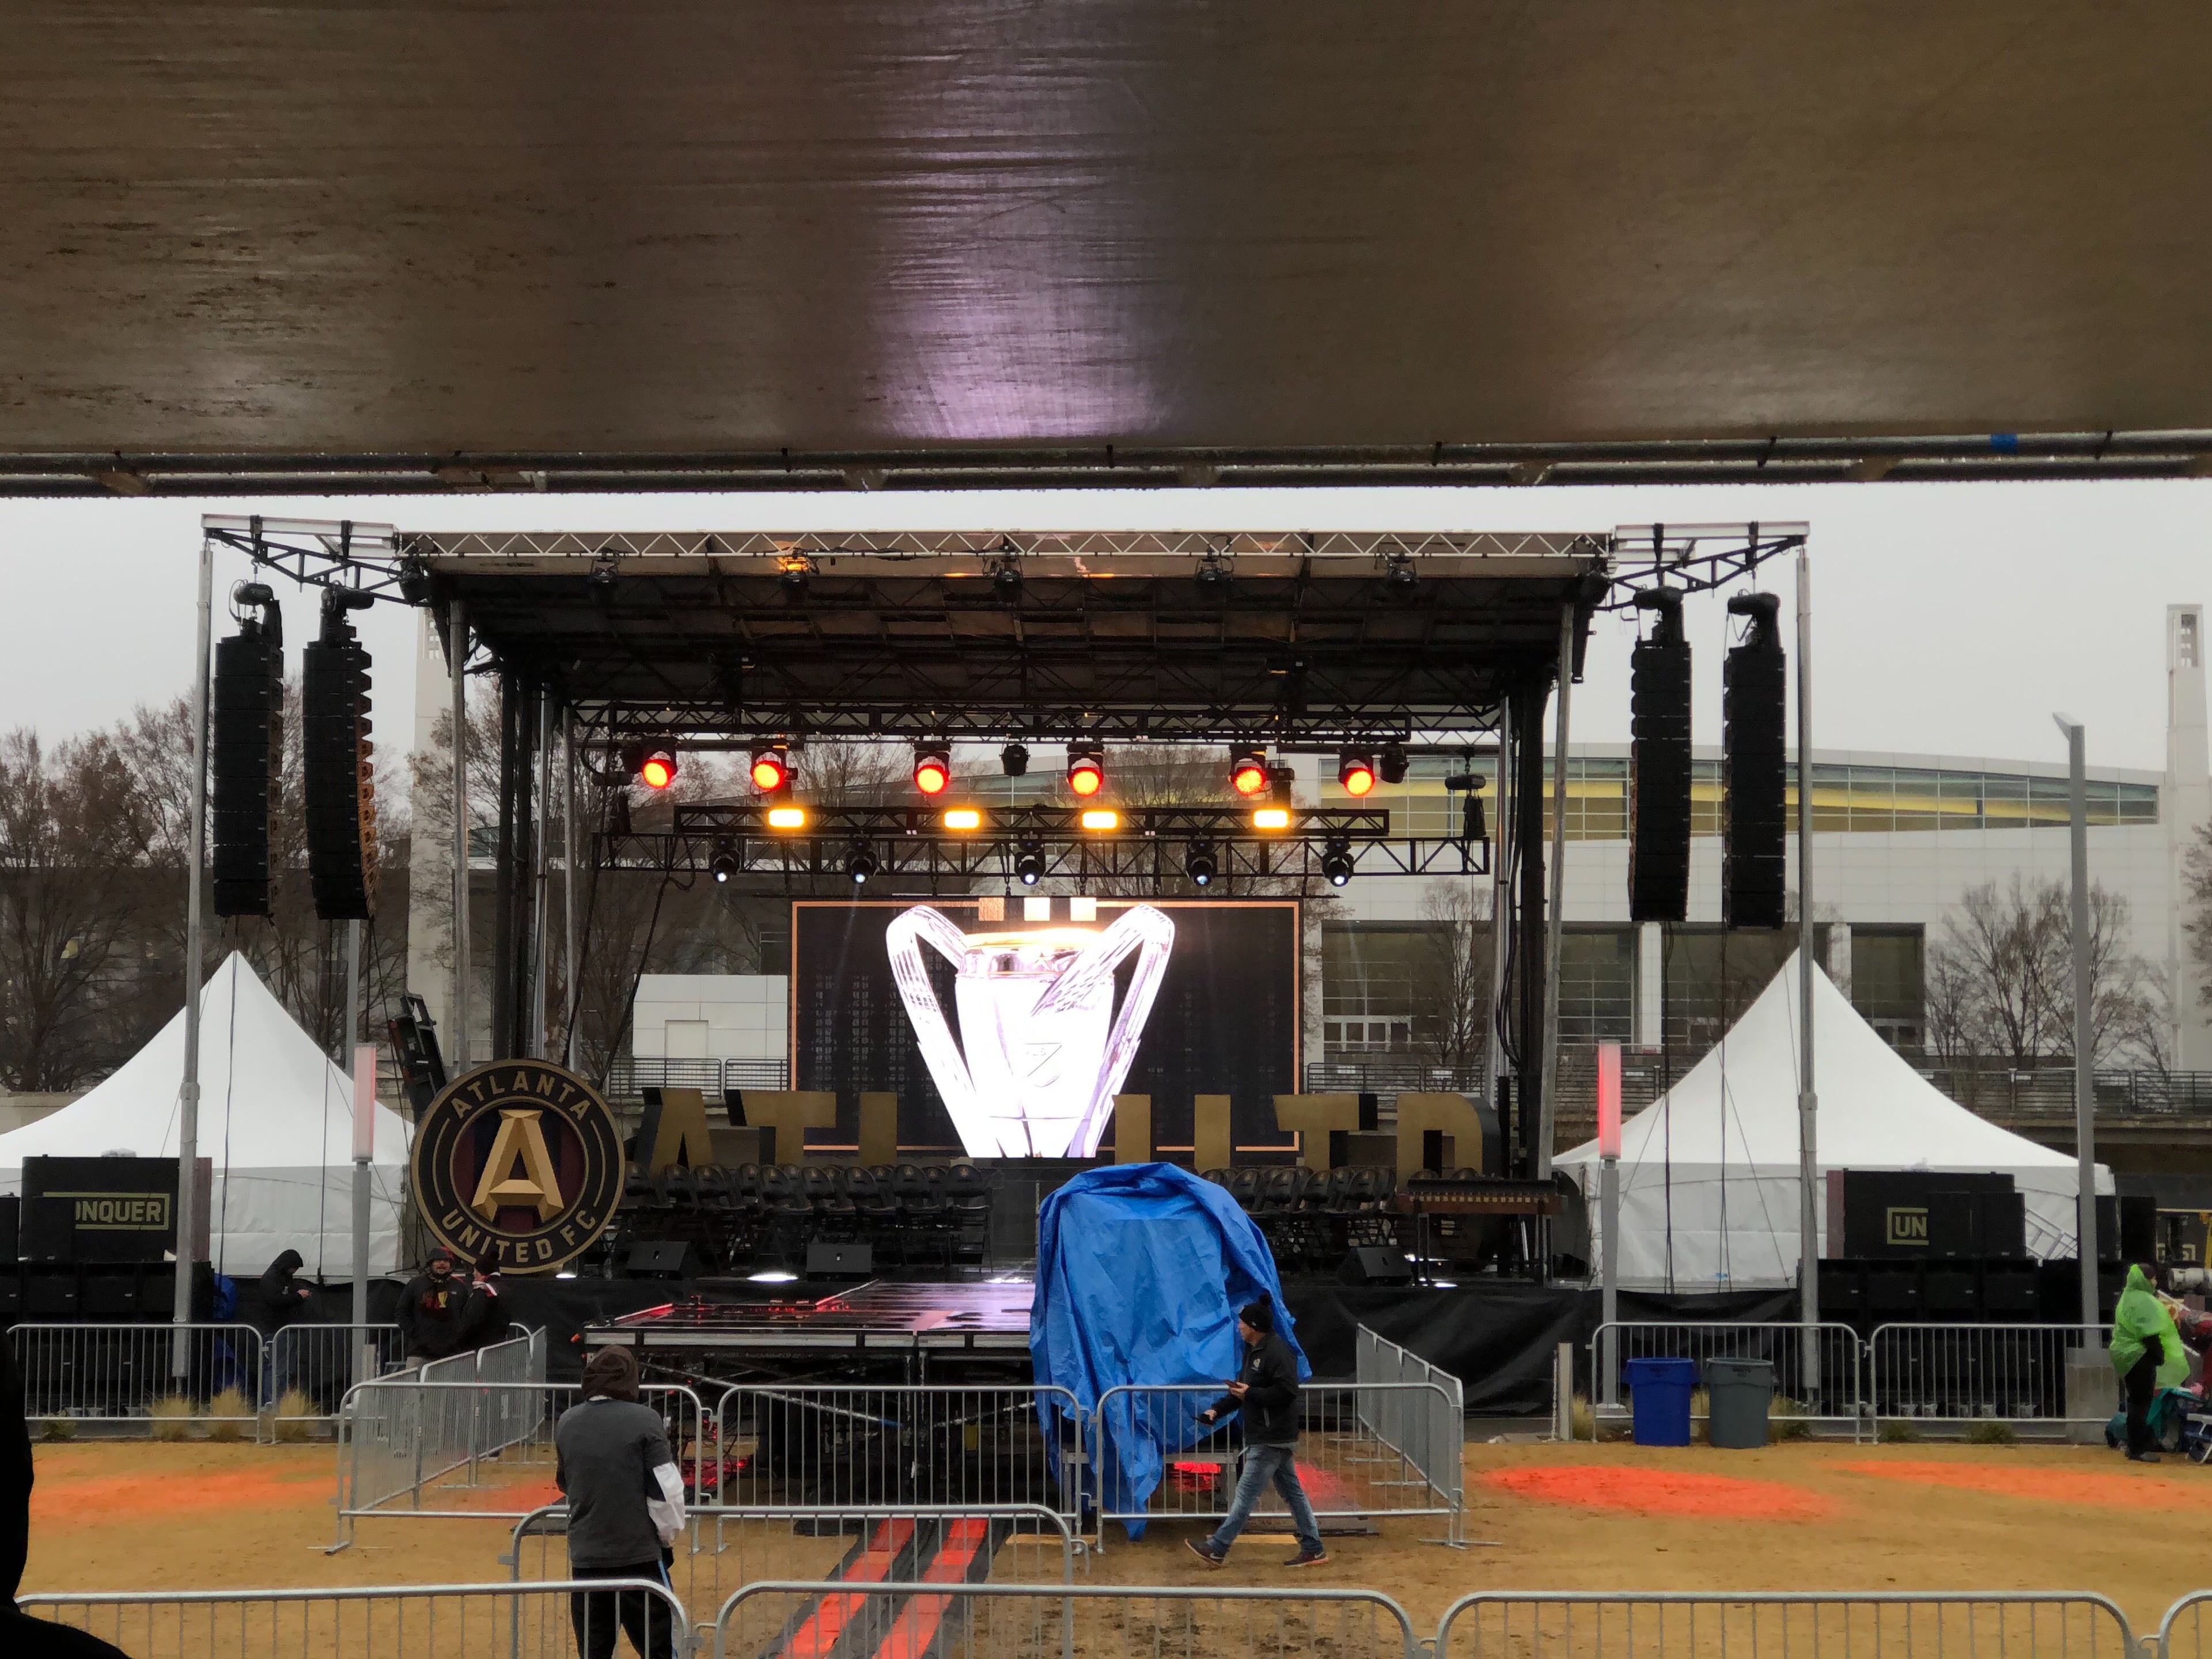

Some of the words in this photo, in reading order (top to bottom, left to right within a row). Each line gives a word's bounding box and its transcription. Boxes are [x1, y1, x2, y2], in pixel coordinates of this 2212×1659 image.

[450, 1071, 591, 1120] ATLANTA
[441, 1209, 554, 1263] UNITED
[559, 1210, 596, 1247] FC
[1895, 1215, 1927, 1237] UN
